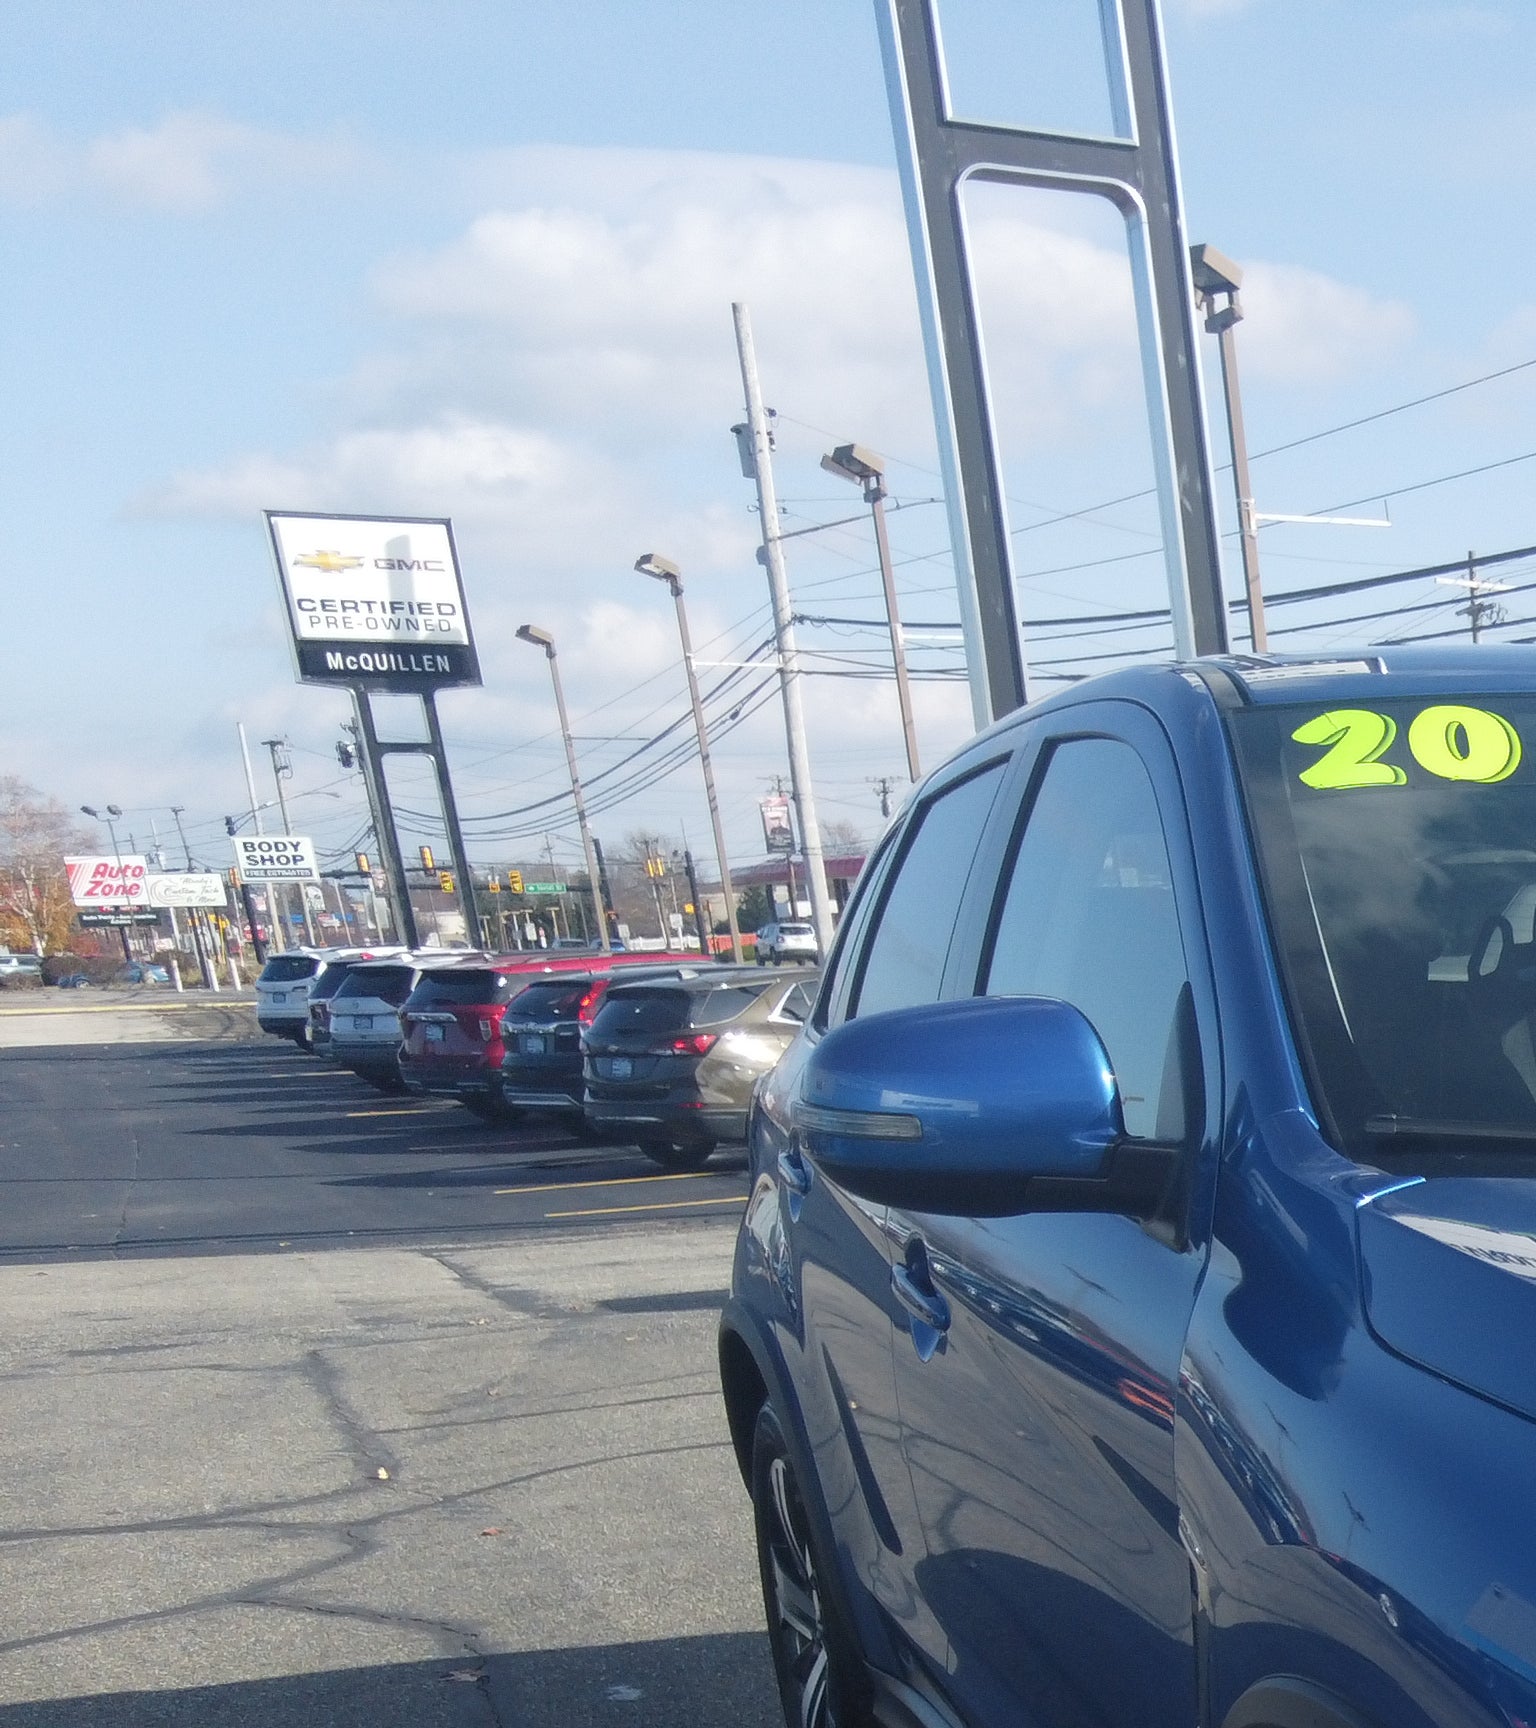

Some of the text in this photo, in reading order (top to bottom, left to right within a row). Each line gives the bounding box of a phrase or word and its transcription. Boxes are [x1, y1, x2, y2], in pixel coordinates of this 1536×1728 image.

[374, 558, 446, 572] GMC
[297, 598, 456, 616] CERTIFIED
[309, 615, 452, 632] PRE-OWNED
[326, 652, 450, 672] McQUILLEN
[1291, 705, 1523, 790] 20
[243, 841, 301, 853] BODY
[246, 854, 305, 866] SHOP
[92, 862, 144, 879] Auto
[84, 880, 141, 897] Zone
